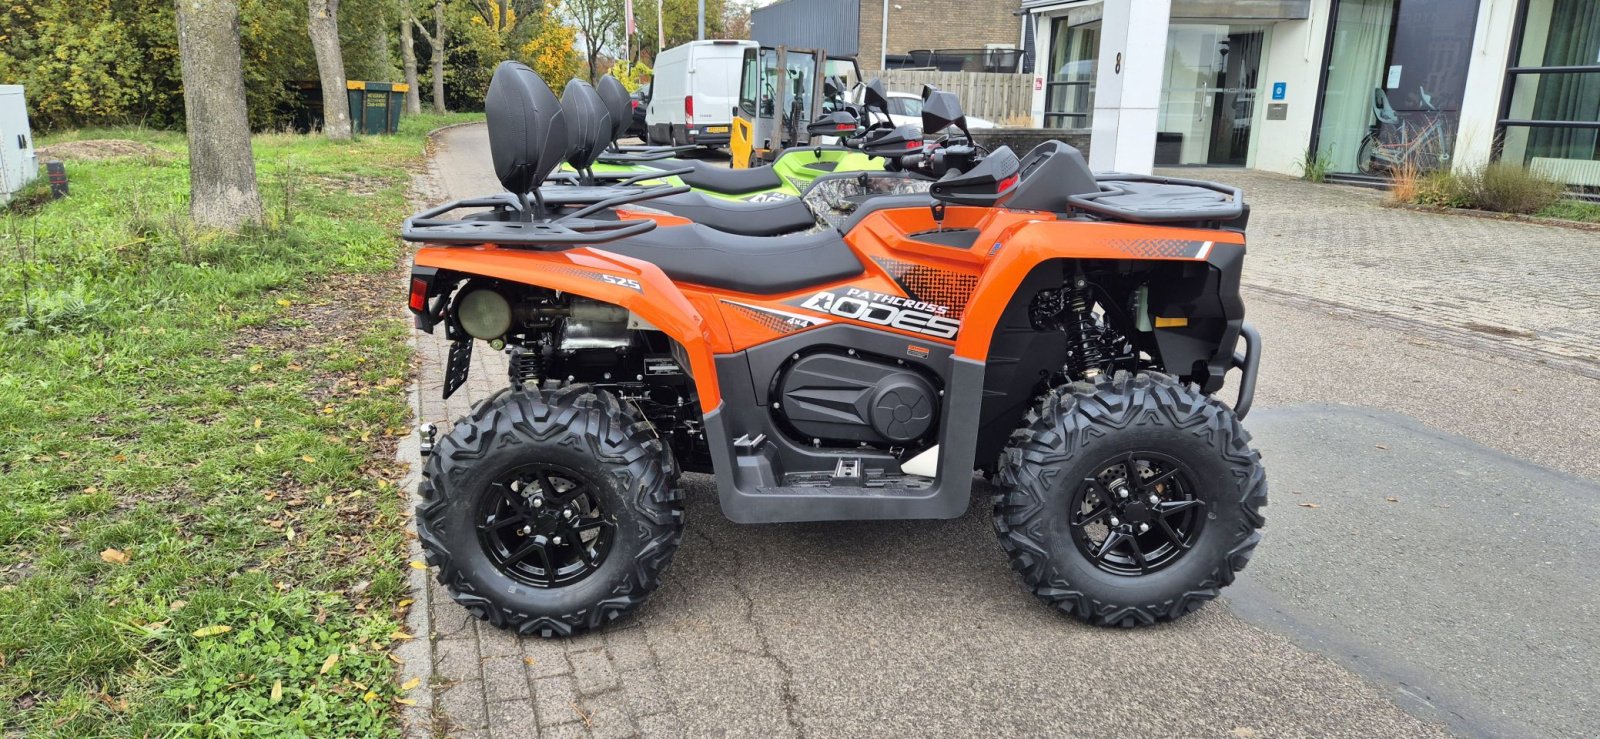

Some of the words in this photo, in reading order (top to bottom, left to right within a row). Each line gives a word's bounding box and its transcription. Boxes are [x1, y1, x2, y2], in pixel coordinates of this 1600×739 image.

[1115, 52, 1122, 74] 8
[602, 274, 641, 290] 525
[847, 288, 950, 315] PATHCROSS
[800, 291, 961, 339] AODES
